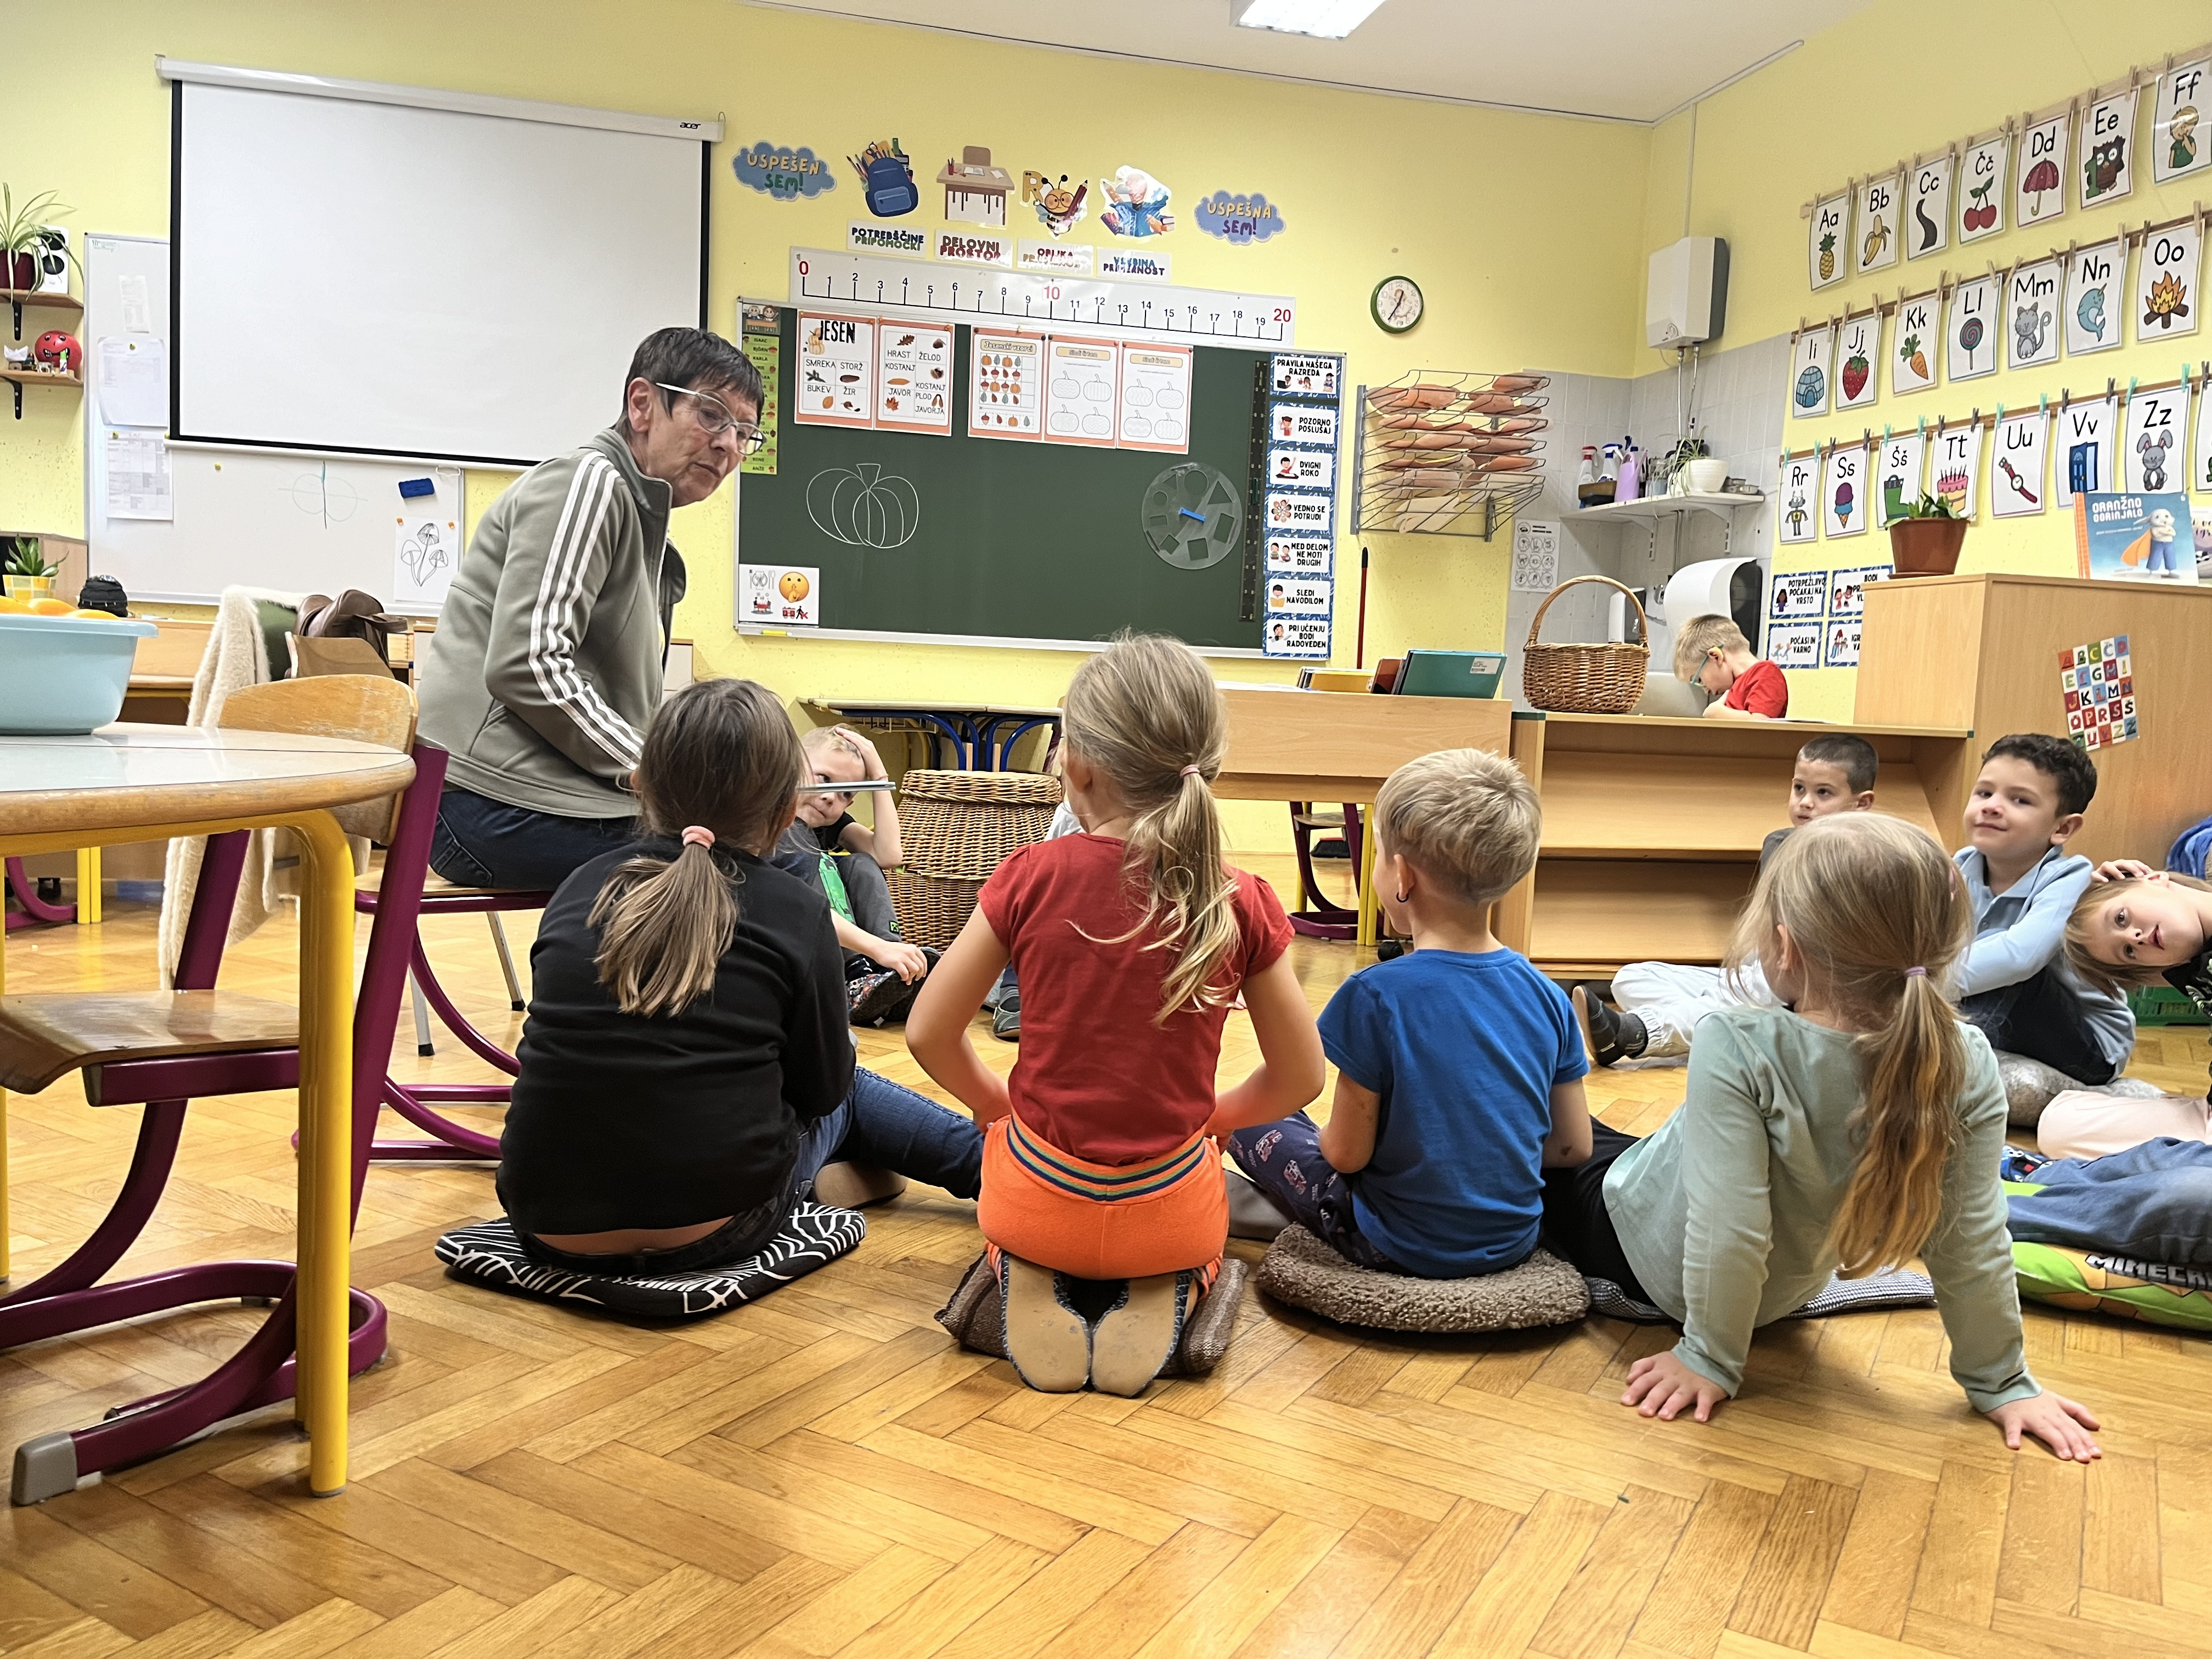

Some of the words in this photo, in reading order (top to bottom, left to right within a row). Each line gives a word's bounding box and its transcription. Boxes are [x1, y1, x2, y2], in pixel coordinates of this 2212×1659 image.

[1819, 208, 1839, 232] Aa
[1869, 187, 1889, 212] Bb
[1920, 171, 1939, 194] Cc
[1976, 150, 1994, 175] Čč
[2032, 126, 2056, 157] Dd
[2095, 106, 2119, 136] Ee
[2174, 70, 2202, 105] Ff
[747, 154, 821, 176] USPEŠEN
[765, 173, 803, 191] SEM!
[1207, 202, 1272, 219] USPEŠNA
[1222, 217, 1256, 235] SEM!
[852, 227, 924, 244] POTREBŠČINE
[943, 235, 999, 252] DELOVNI
[799, 261, 809, 275] 0
[827, 276, 831, 285] 1
[853, 273, 858, 281] 2
[878, 280, 883, 289] 3
[902, 278, 908, 286] 4
[928, 285, 933, 294] 5
[952, 283, 958, 291] 6
[978, 290, 983, 298] 7
[1044, 286, 1060, 300] 10
[1070, 300, 1080, 308] 11
[1095, 297, 1105, 305] 12
[1118, 304, 1128, 313] 13
[1141, 301, 1152, 309] 14
[1164, 309, 1175, 317] 15
[1187, 306, 1198, 314] 16
[1210, 313, 1220, 321] 17
[1233, 311, 1243, 319] 18
[1255, 317, 1266, 325] 19
[1273, 308, 1291, 323] 20
[1809, 339, 1817, 360] Ii
[1848, 326, 1864, 354] Jj
[1906, 306, 1927, 331] Kk
[1964, 287, 1982, 314] Ll
[2015, 273, 2054, 302] Mm
[2082, 255, 2111, 284] Nn
[2154, 238, 2185, 266] Oo
[818, 320, 855, 343] JESEN
[888, 350, 911, 359] HRAST
[919, 352, 941, 362] ŽELOD
[806, 359, 836, 368] SMREKA
[840, 362, 863, 371] STORŽ
[885, 363, 916, 371] KOSTANJ
[1277, 359, 1304, 368] PRAVILA
[1306, 360, 1332, 369] NAŠEGA
[1289, 368, 1320, 376] RAZREDA
[807, 385, 831, 393] BUKEV
[843, 386, 856, 395] ŽIR
[888, 388, 911, 397] JAVOR
[915, 406, 945, 415] JAVORJA
[1300, 417, 1330, 426] POZORNO
[1299, 424, 1331, 434] POSLUŠAJ
[1792, 466, 1809, 487] Rr
[1837, 456, 1855, 479] Ss
[1892, 446, 1908, 467] Šš
[1946, 435, 1968, 461] Tt
[2007, 424, 2033, 450] Uu
[2073, 411, 2098, 437] Vv
[2143, 400, 2172, 428] Zz
[2092, 496, 2142, 513] ORANŽNO
[1788, 575, 1826, 588] POTRPEŽLJIVO
[1864, 574, 1878, 582] BODI
[1790, 586, 1814, 596] POČAKAJ
[1815, 586, 1821, 595] NA
[1286, 596, 1324, 605] NAVODILOM
[1301, 623, 1325, 632] UČENJU
[1790, 635, 1809, 645] POČASI
[2077, 650, 2086, 665] B
[2090, 647, 2098, 660] C
[2118, 641, 2126, 653] D
[2066, 673, 2075, 688] E
[2092, 667, 2102, 680] G
[2107, 664, 2116, 677] H
[2068, 694, 2078, 709] J
[2081, 691, 2092, 706] K
[2108, 684, 2120, 698] M
[2070, 715, 2081, 730] O
[2085, 711, 2094, 725] P
[2098, 708, 2107, 723] R
[2113, 704, 2120, 717] S
[2087, 731, 2098, 746] U
[2113, 724, 2125, 739] Z
